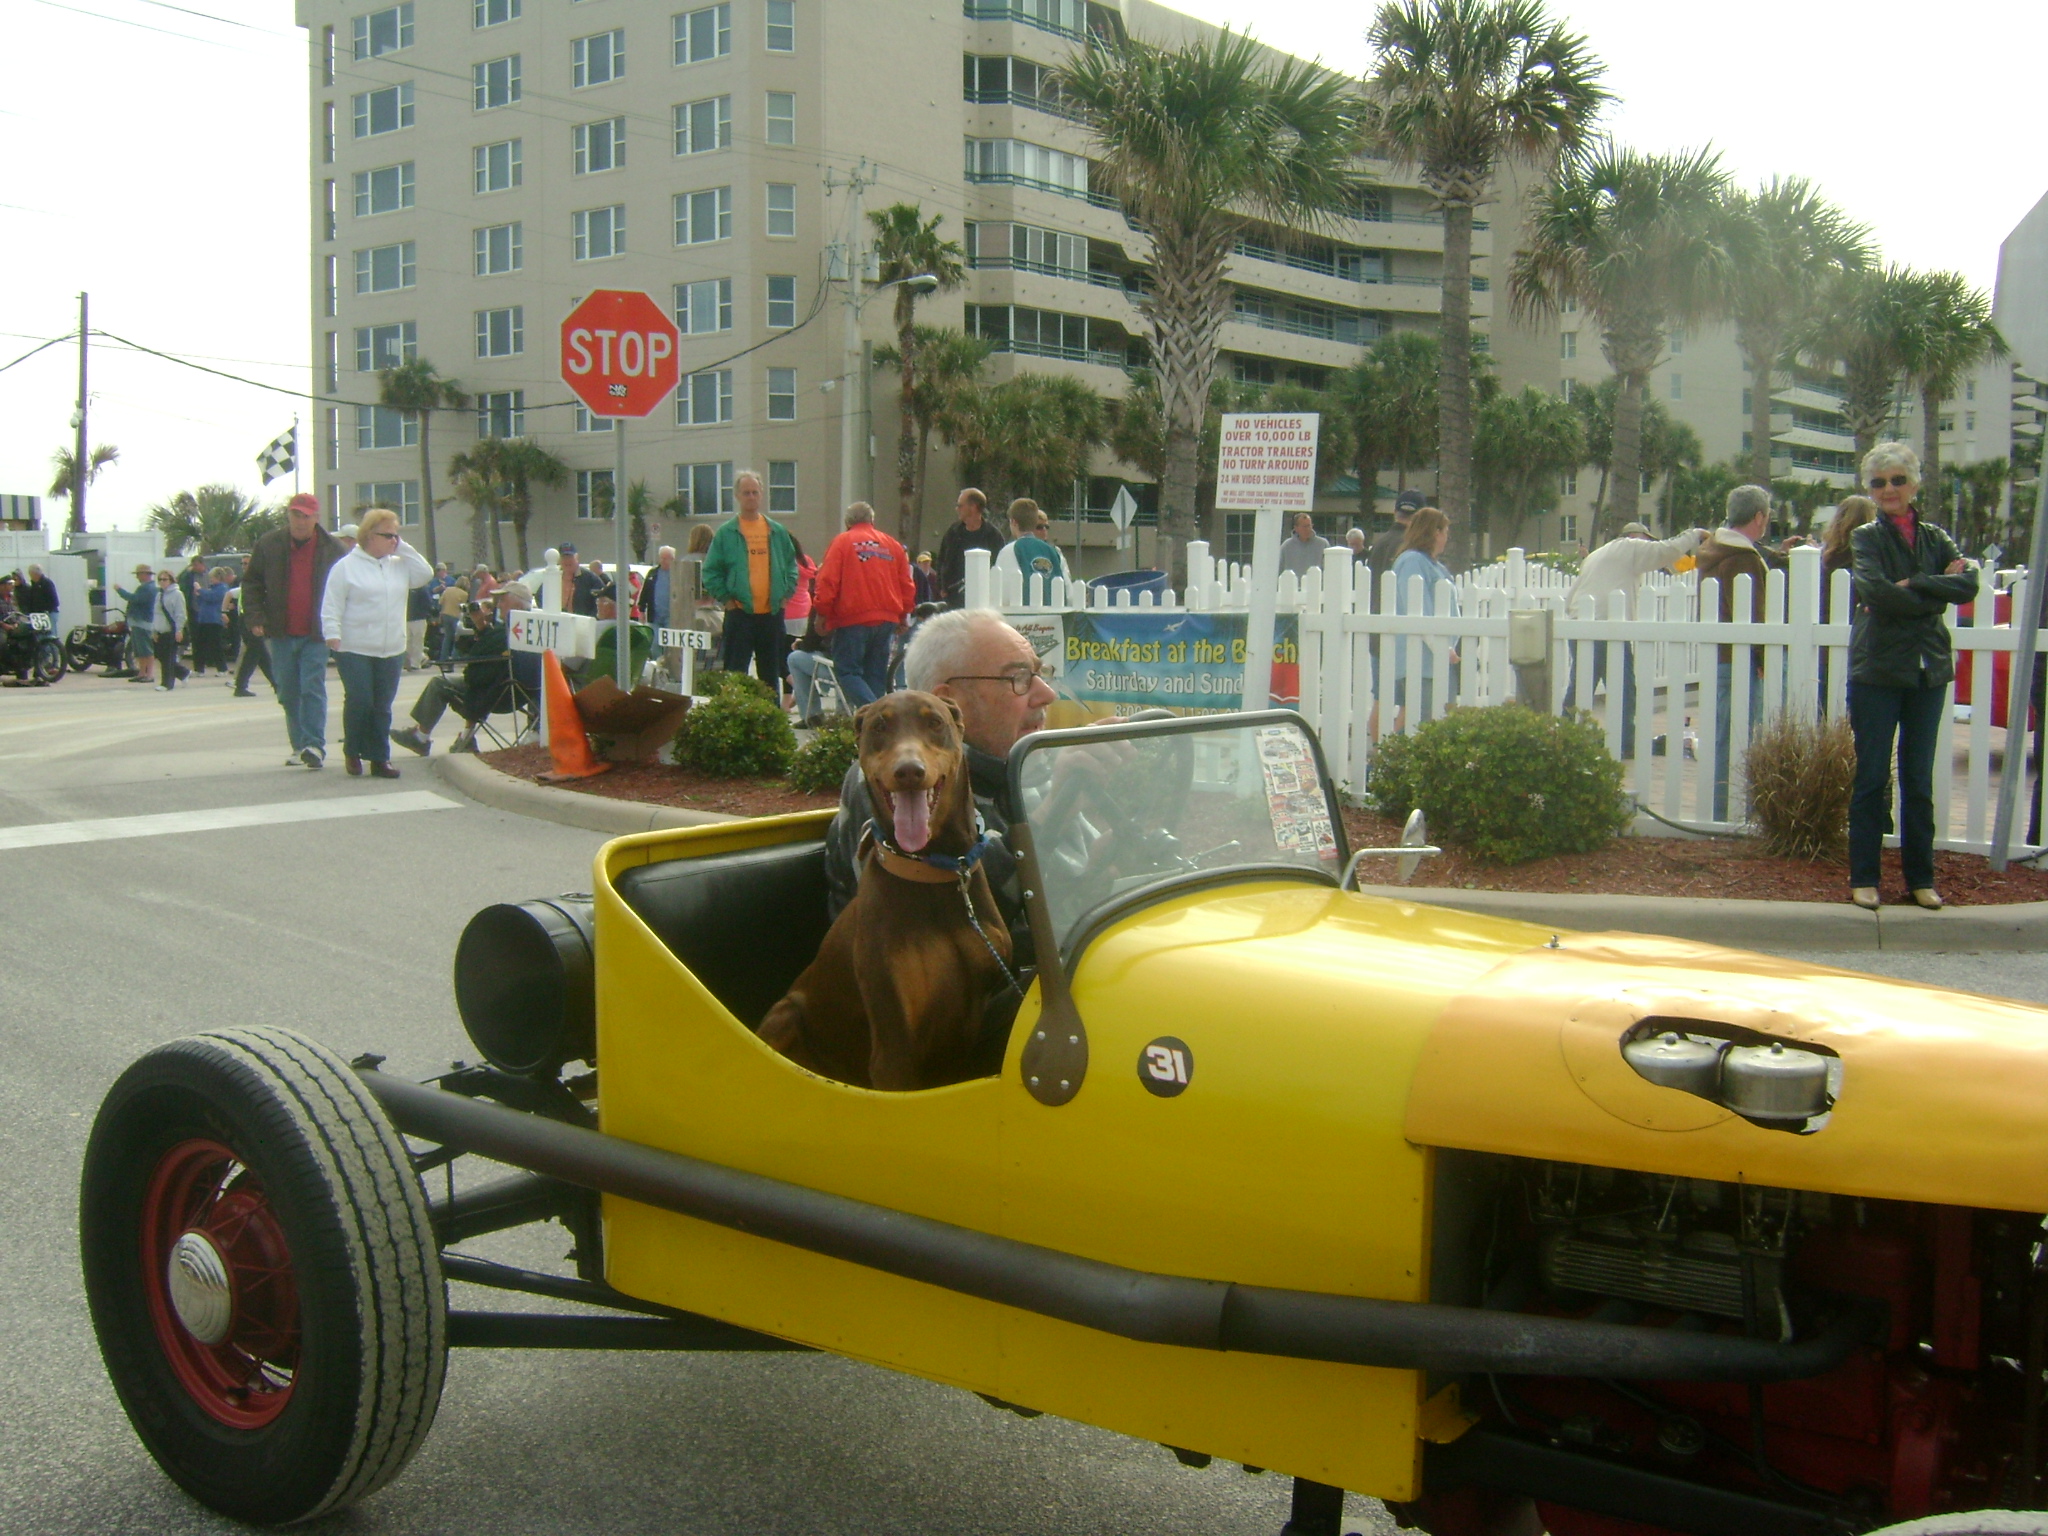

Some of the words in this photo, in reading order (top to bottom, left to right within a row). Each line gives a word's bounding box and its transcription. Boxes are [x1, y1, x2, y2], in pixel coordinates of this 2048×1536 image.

[568, 328, 672, 378] STOP
[1235, 419, 1250, 429] NO
[1253, 419, 1302, 429] VEHICLES
[1225, 431, 1252, 441] OVER
[1255, 431, 1295, 442] 10,000
[1298, 431, 1311, 441] LB
[1221, 446, 1264, 457] TRACTOR
[1267, 446, 1314, 457] TRAILERS
[1222, 459, 1236, 470] NO
[1239, 459, 1264, 470] TURN
[1267, 459, 1310, 470] AROUND
[1220, 474, 1229, 484] 24
[1231, 474, 1240, 484] HR
[1241, 474, 1261, 484] VIDEO
[1262, 474, 1310, 485] SURVEILLANCE
[31, 614, 51, 630] 35
[526, 618, 560, 649] EXIT
[661, 630, 704, 648] BIKES
[1066, 636, 1162, 664] Breakfast
[1167, 640, 1188, 663] at
[1193, 638, 1226, 664] the
[1231, 637, 1297, 664] Bch
[1086, 669, 1158, 693] Saturday
[1163, 672, 1195, 694] and
[1200, 672, 1244, 695] Sund
[1146, 1045, 1188, 1084] 31
